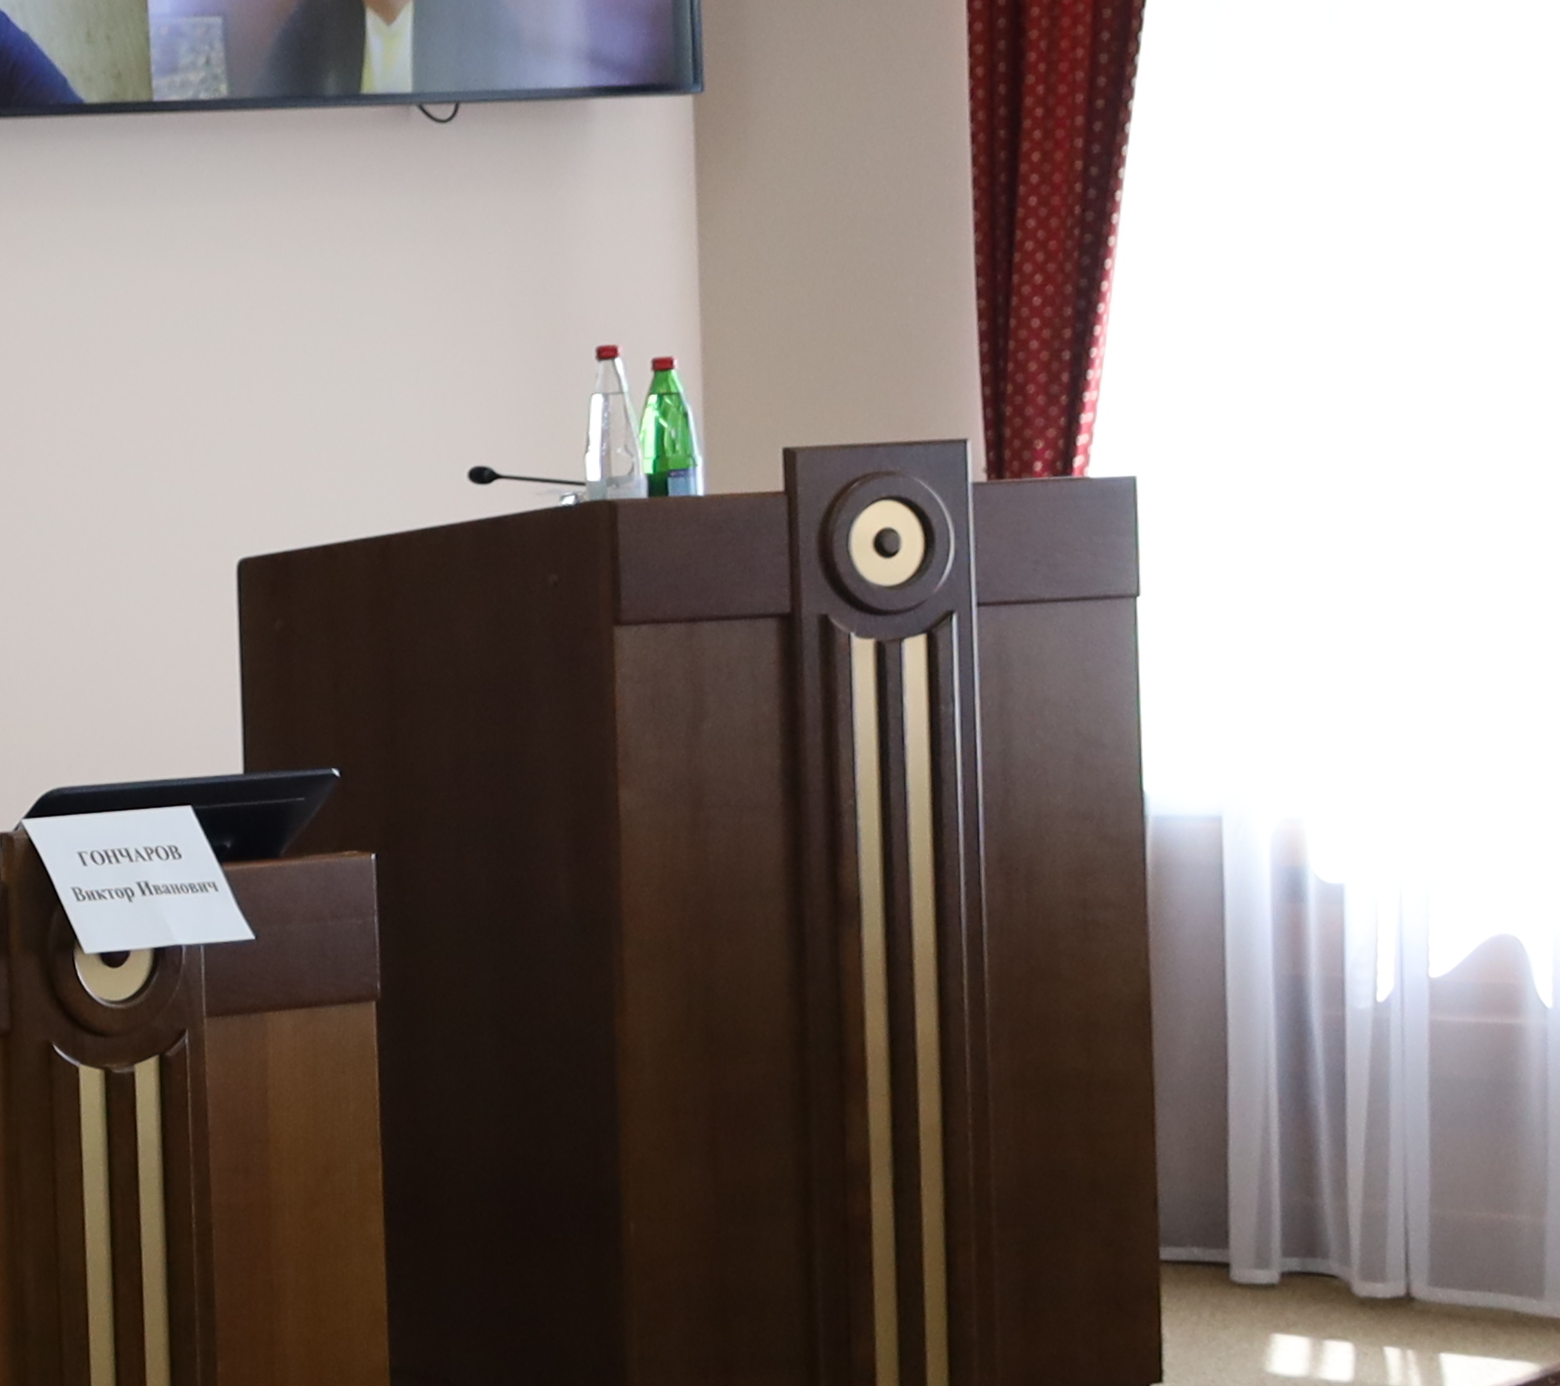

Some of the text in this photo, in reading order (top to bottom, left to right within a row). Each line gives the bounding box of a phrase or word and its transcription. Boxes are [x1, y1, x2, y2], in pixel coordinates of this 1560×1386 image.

[77, 845, 183, 867] ГОНЧАРОВ
[71, 880, 219, 903] Виктор Иванович
